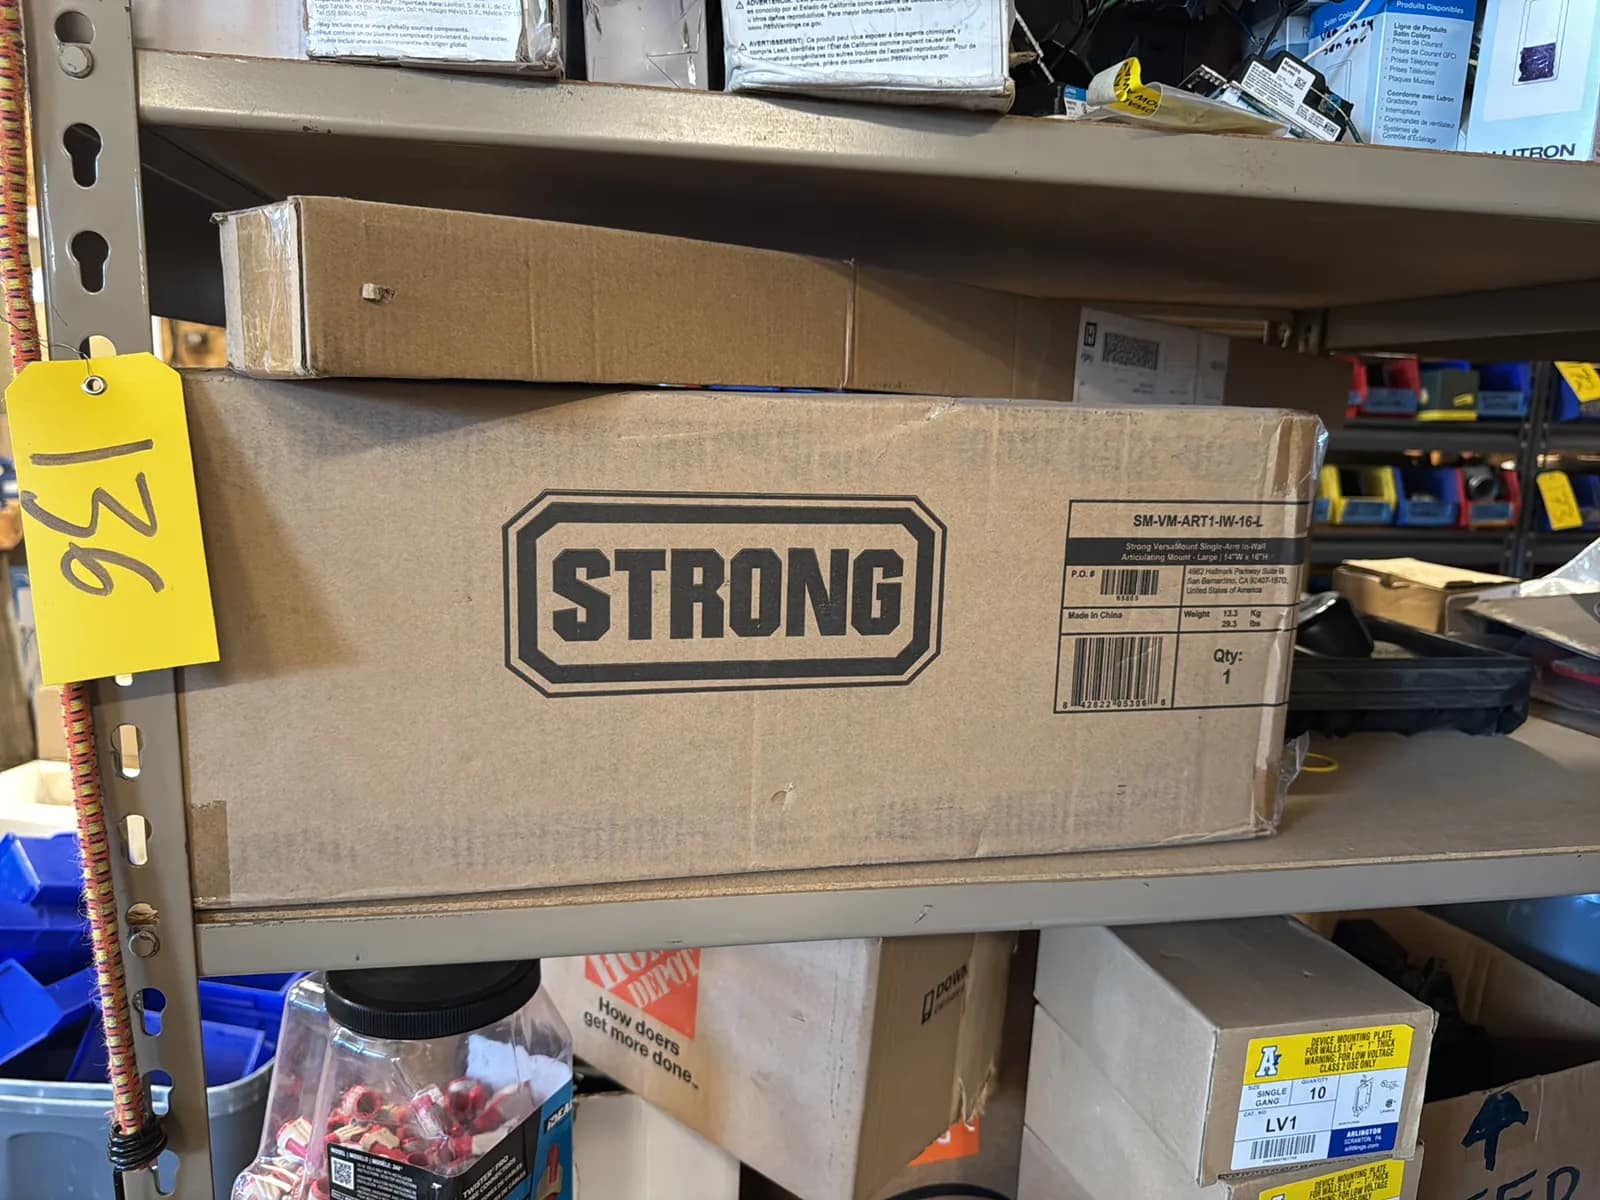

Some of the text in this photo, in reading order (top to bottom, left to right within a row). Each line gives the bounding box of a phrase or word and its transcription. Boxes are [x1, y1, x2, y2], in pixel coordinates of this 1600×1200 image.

[1396, 1, 1464, 14] Produits Disponibles
[1392, 30, 1431, 40] Satin Colors
[1393, 22, 1412, 31] Ligne
[1421, 24, 1448, 34] Produits
[20, 438, 165, 597] 136
[1132, 514, 1265, 528] SM-VM-ART1-IW-16-L
[1125, 542, 1151, 552] Strong
[1152, 542, 1198, 551] VersaMount
[1199, 542, 1240, 552] Single-Arm
[1120, 553, 1165, 562] Articulating
[1167, 553, 1192, 561] Mount
[1197, 554, 1218, 563] Large
[1071, 570, 1088, 578] P.O.
[552, 547, 904, 642] STRONG
[1228, 586, 1237, 594] of
[1100, 611, 1123, 619] China
[1183, 610, 1210, 619] Weight
[1250, 609, 1262, 618] Kg
[1213, 648, 1244, 665] Qty:
[1222, 669, 1231, 685] 1
[598, 997, 681, 1057] How doers
[583, 1011, 609, 1034] get
[610, 1025, 650, 1058] more
[1311, 1029, 1393, 1047] DEVICE MOUNTING PLATE
[1304, 1046, 1319, 1056] FOR
[1319, 1044, 1342, 1055] WALLS
[1376, 1038, 1396, 1048] THICK
[1303, 1047, 1395, 1066] WARNING: FOR LOW VOLTAGE
[1319, 1062, 1341, 1074] CLASS
[1346, 1060, 1359, 1071] USE
[1359, 1058, 1377, 1069] ONLY
[1256, 1087, 1288, 1099] SINGLE
[1309, 1085, 1327, 1101] 10
[1255, 1097, 1281, 1108] GANG
[1265, 1115, 1298, 1134] LV1
[1346, 1127, 1383, 1138] ARLINGTON
